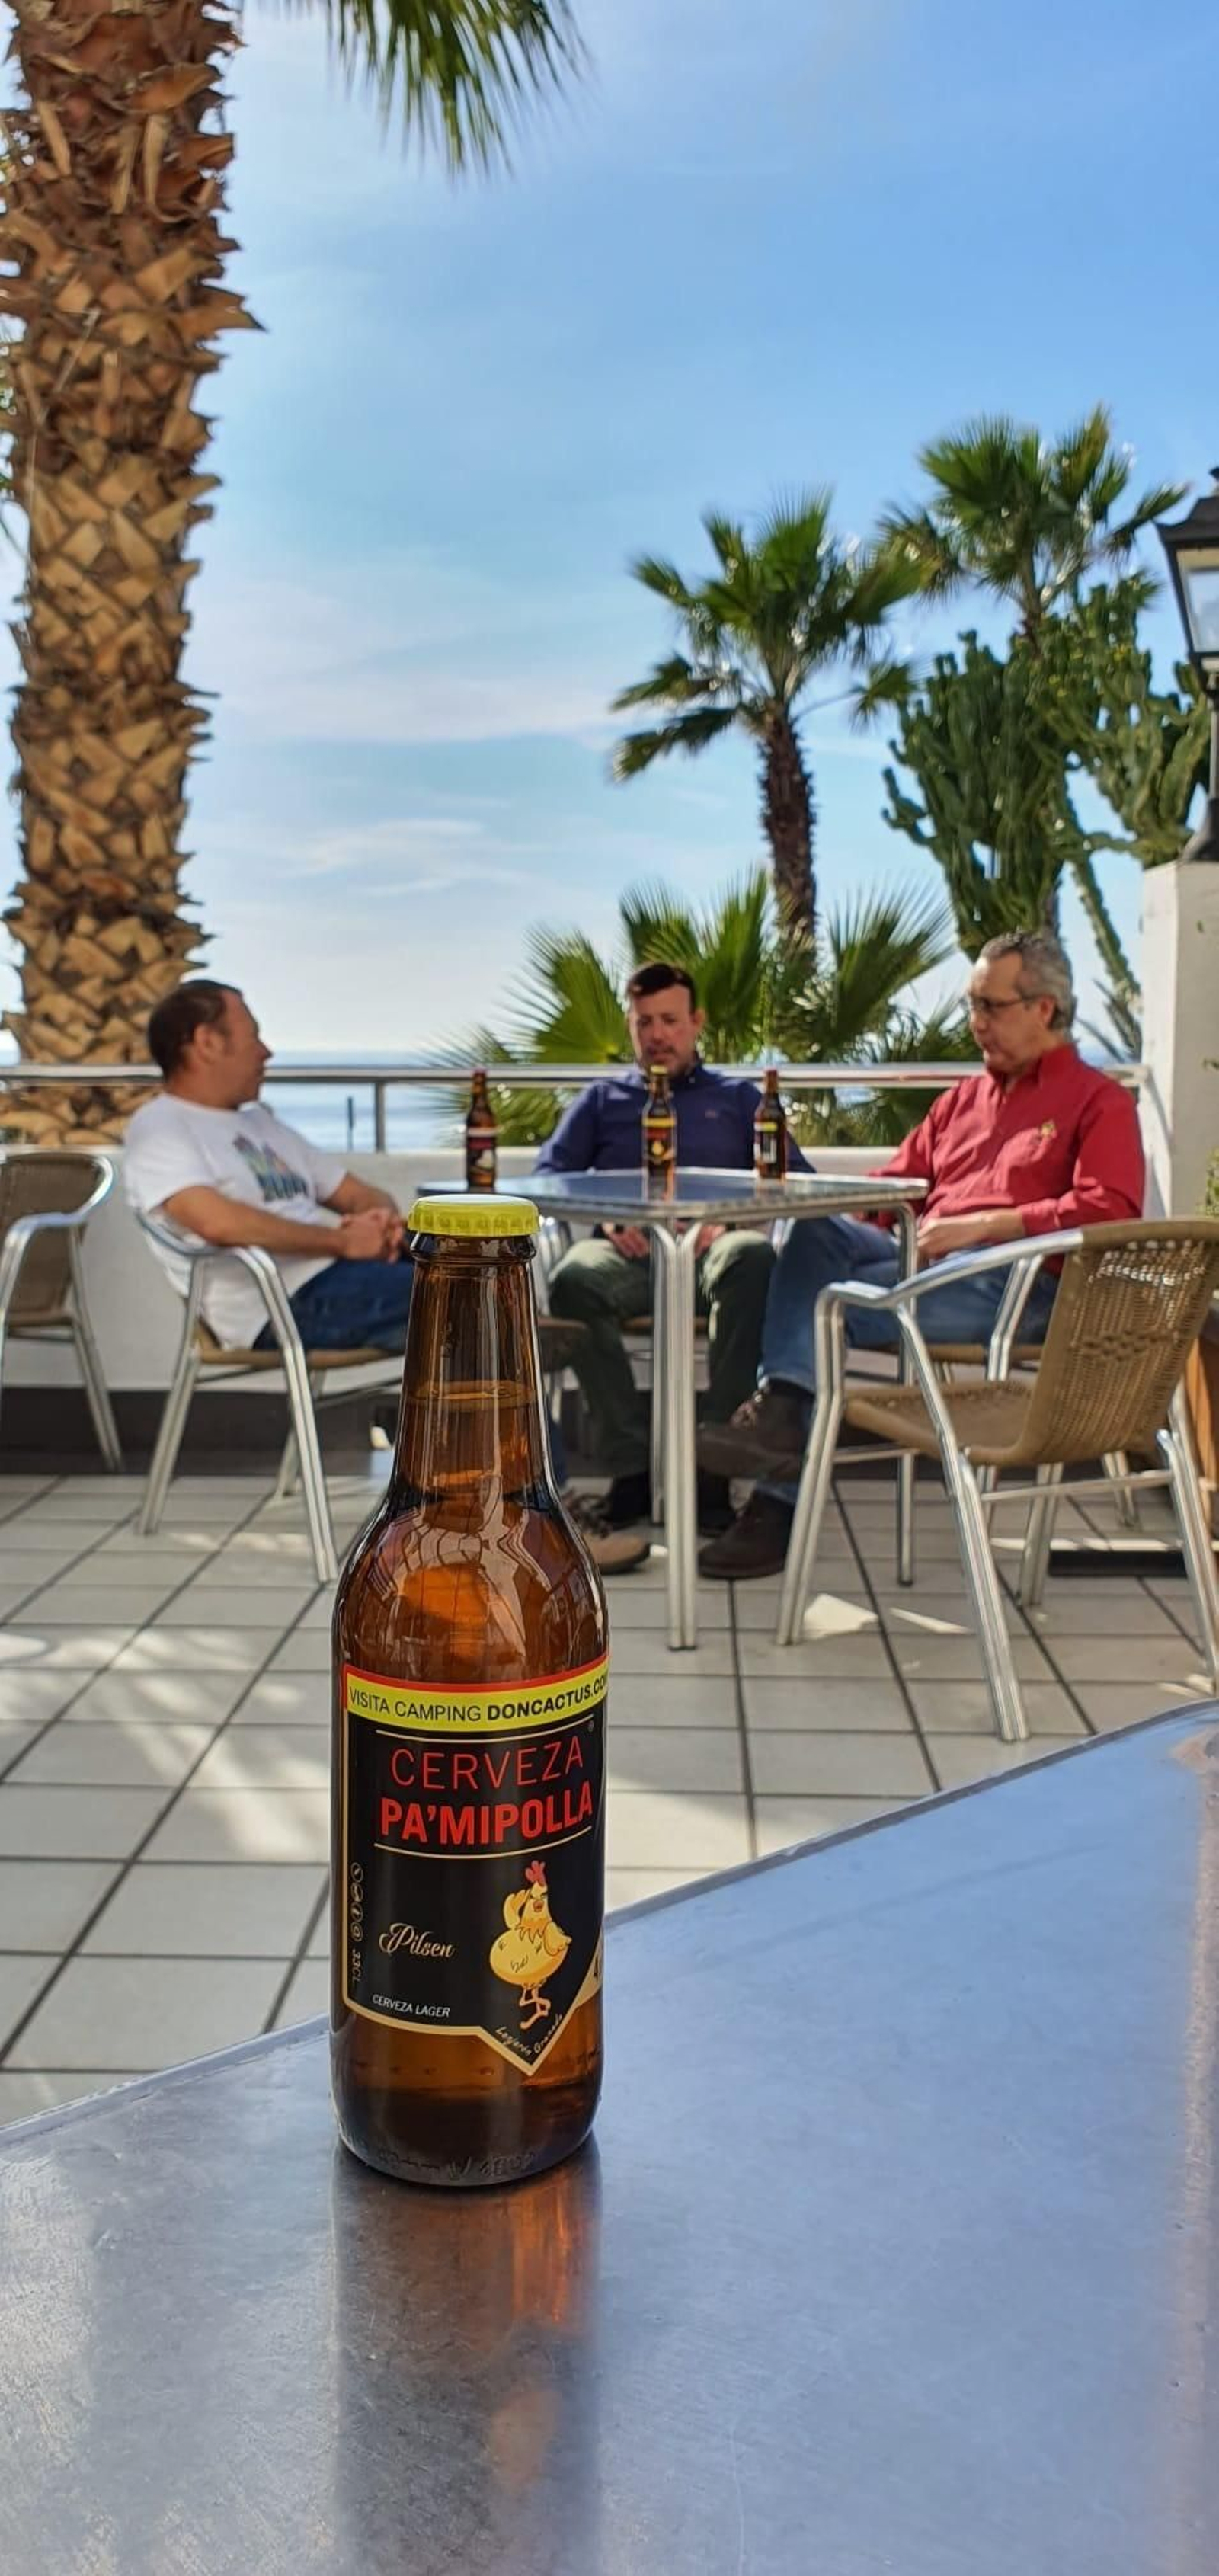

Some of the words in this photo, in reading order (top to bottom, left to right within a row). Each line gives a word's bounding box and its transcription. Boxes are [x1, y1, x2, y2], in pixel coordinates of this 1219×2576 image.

[349, 1685, 390, 1714] VISITA
[395, 1701, 482, 1721] CAMPING
[391, 1735, 584, 1789] CERVEZA
[379, 1779, 593, 1845] PA'MIPOLLA
[379, 1922, 456, 1958] Pilsen
[372, 1994, 413, 2014] CERVEZA
[415, 2004, 451, 2018] LAGER
